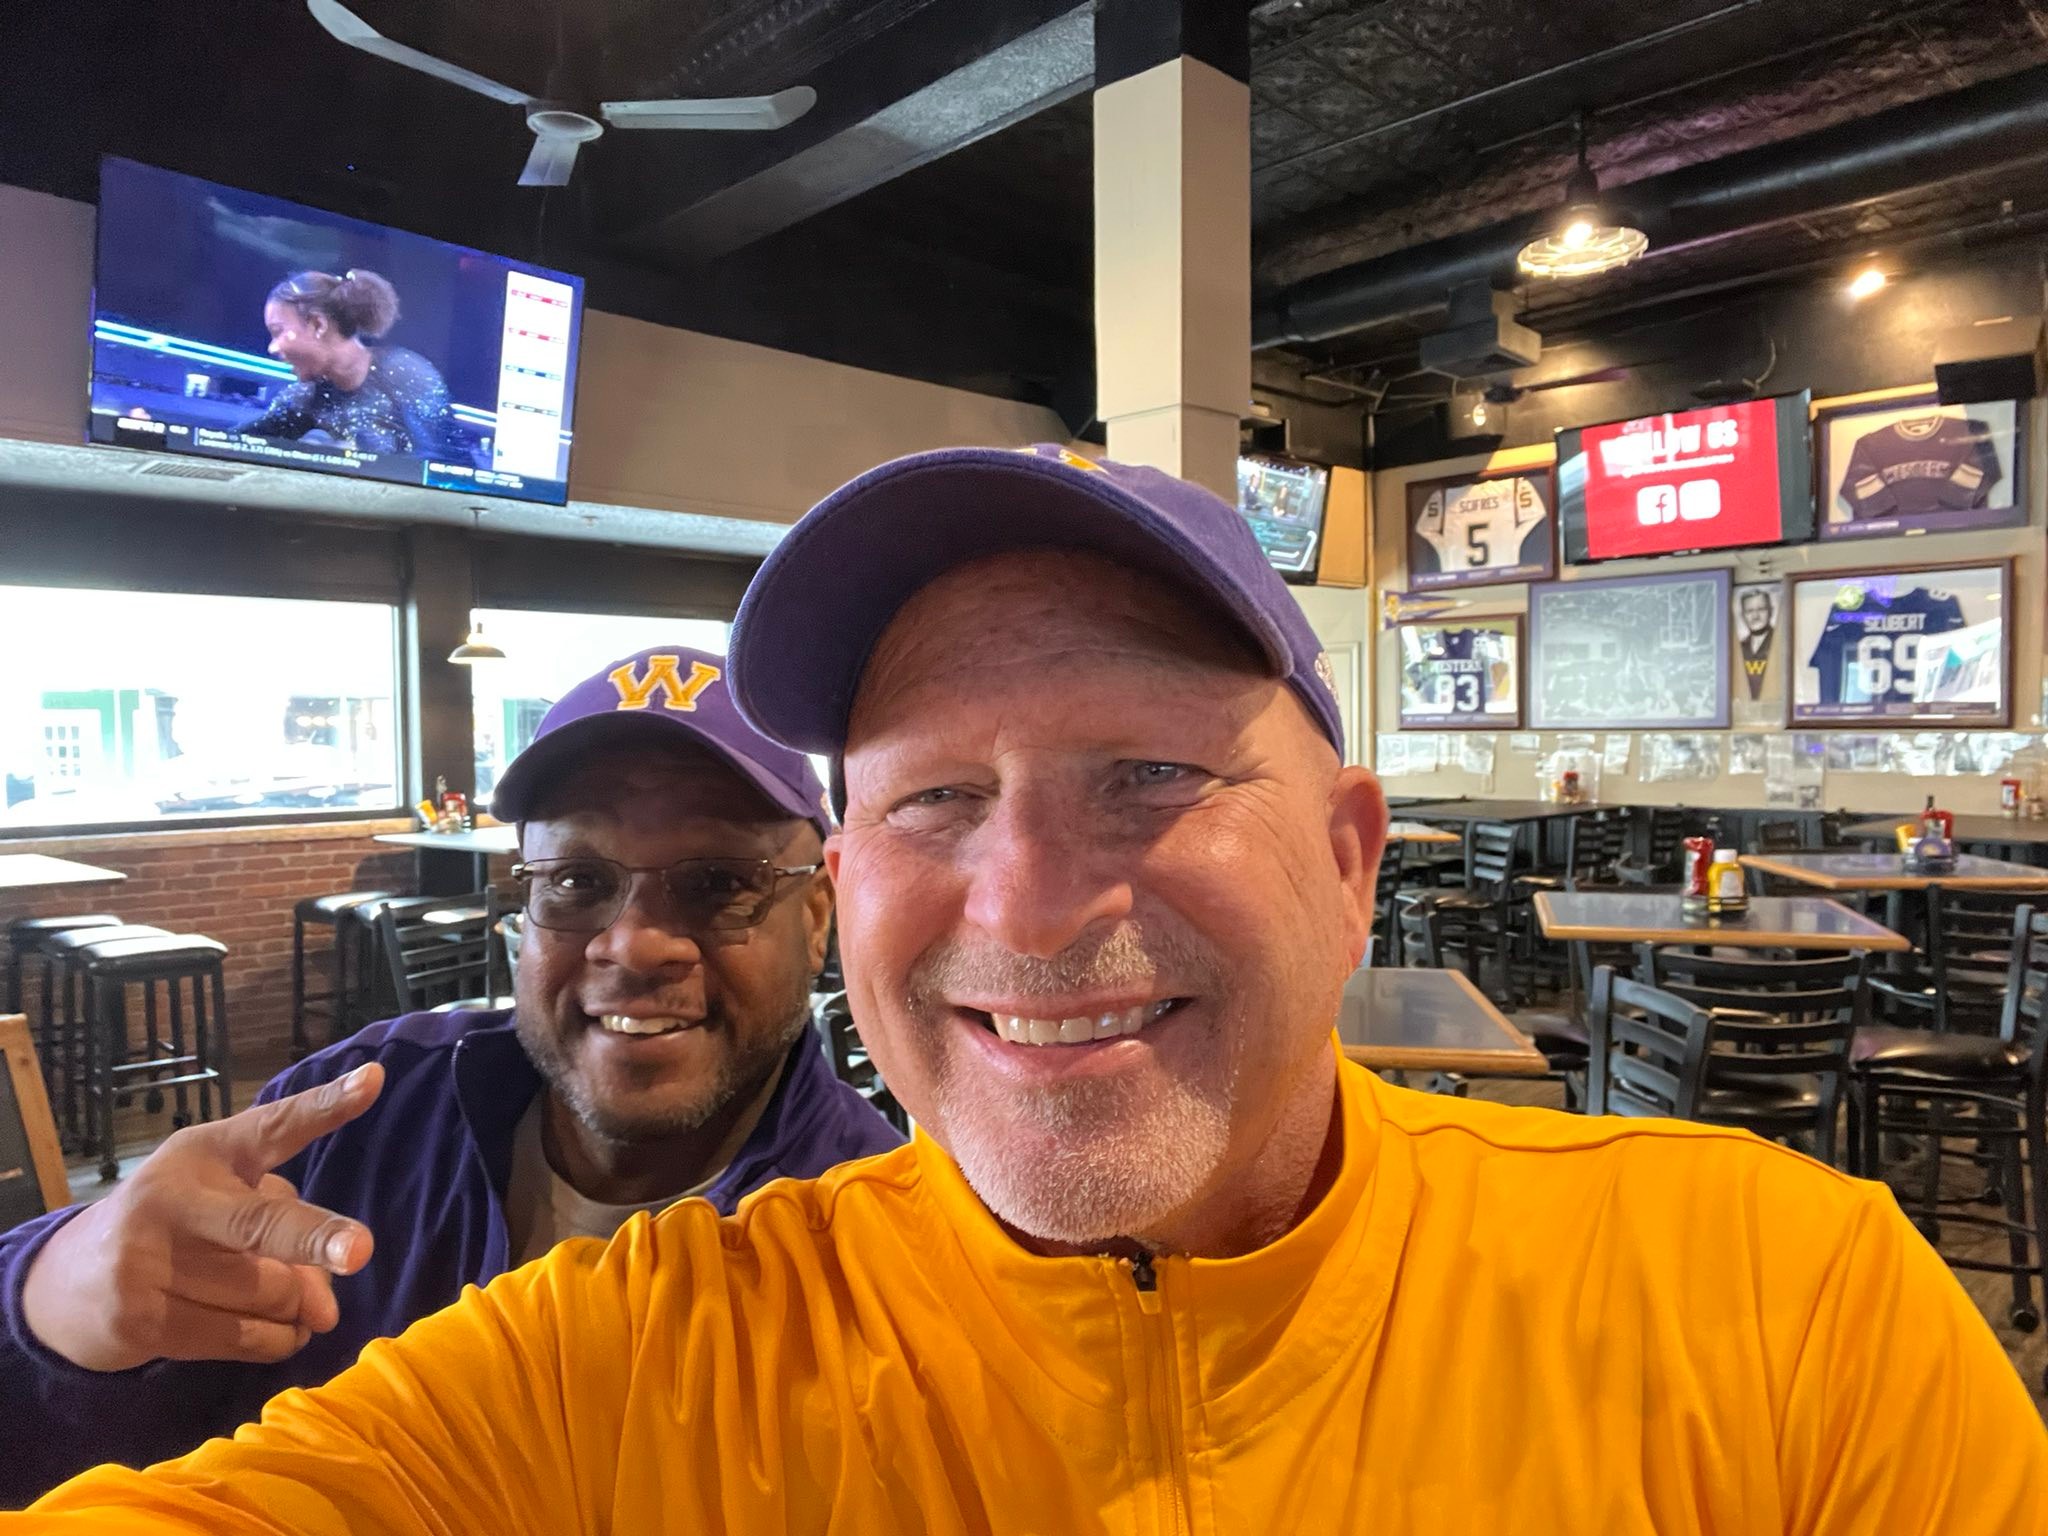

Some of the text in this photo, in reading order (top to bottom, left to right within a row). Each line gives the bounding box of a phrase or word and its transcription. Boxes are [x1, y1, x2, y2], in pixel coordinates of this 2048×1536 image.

[1467, 522, 1489, 567] 5
[607, 654, 721, 712] W
[1744, 660, 1767, 675] W
[1856, 633, 1924, 698] 69
[1433, 673, 1481, 713] 83
